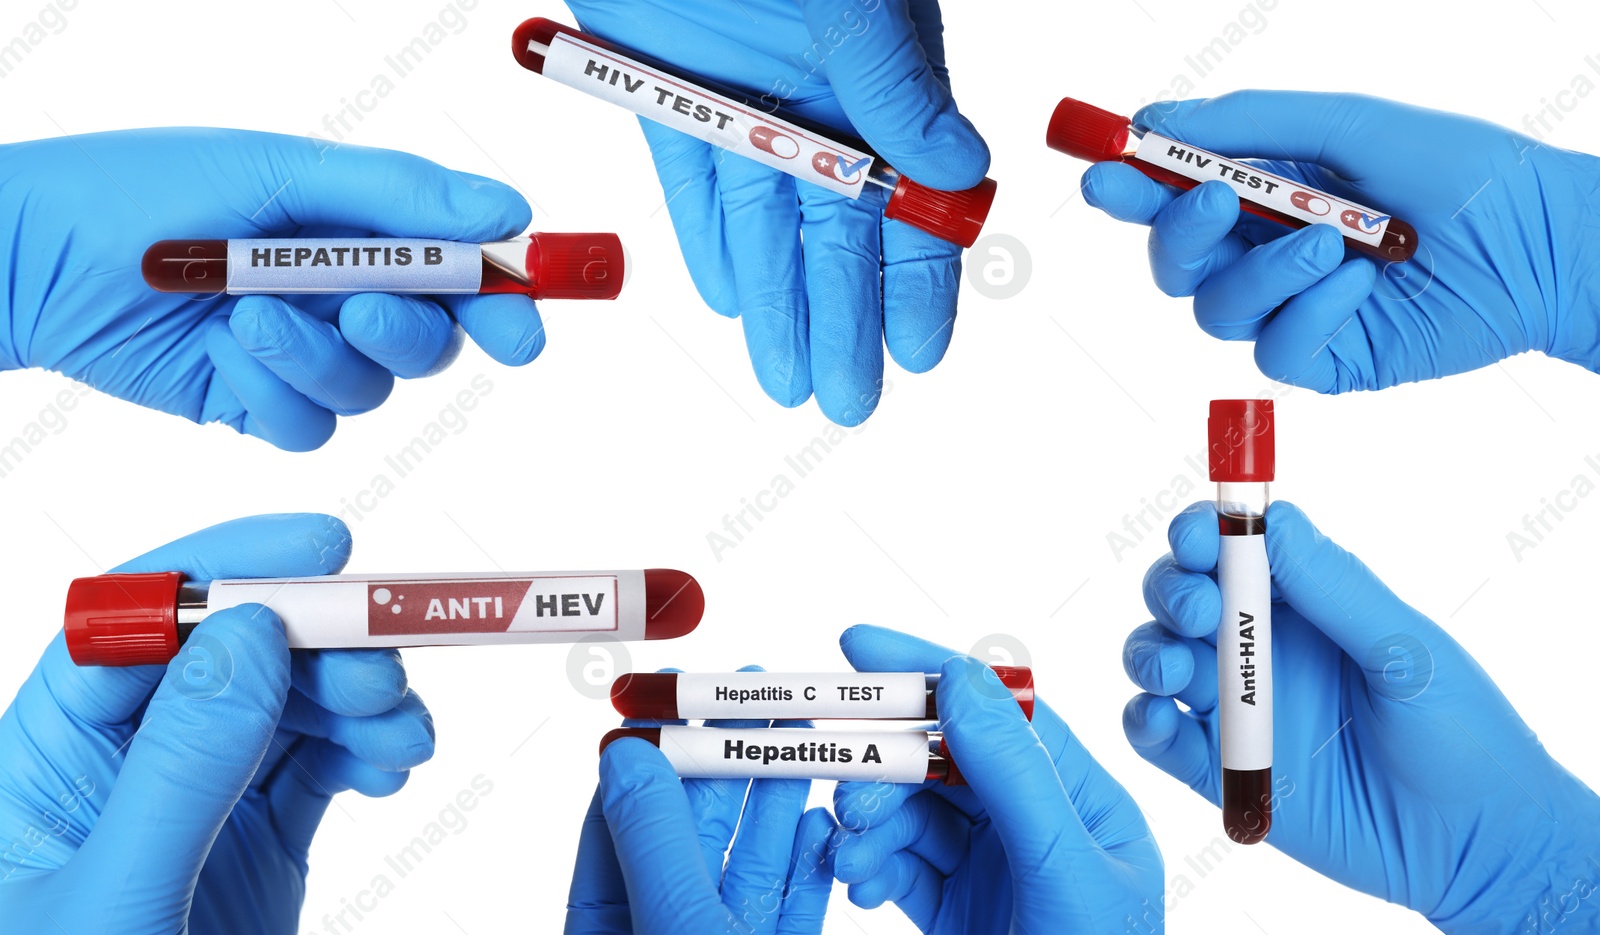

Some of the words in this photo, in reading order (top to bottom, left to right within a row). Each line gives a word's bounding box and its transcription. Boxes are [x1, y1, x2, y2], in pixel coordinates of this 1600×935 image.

[583, 59, 645, 93] HIV
[653, 86, 734, 131] TEST
[1167, 145, 1212, 168] HIV
[1218, 163, 1279, 194] TEST
[251, 247, 413, 267] HEPATITIS
[424, 246, 443, 266] B
[424, 596, 504, 621] ANTI
[535, 593, 605, 617] HEV
[1239, 611, 1256, 706] Anti-HAV
[715, 686, 793, 704] Hepatitis
[803, 686, 817, 701] C
[837, 686, 884, 701] TEST
[723, 739, 853, 765] Hepatitis
[861, 743, 882, 764] A
